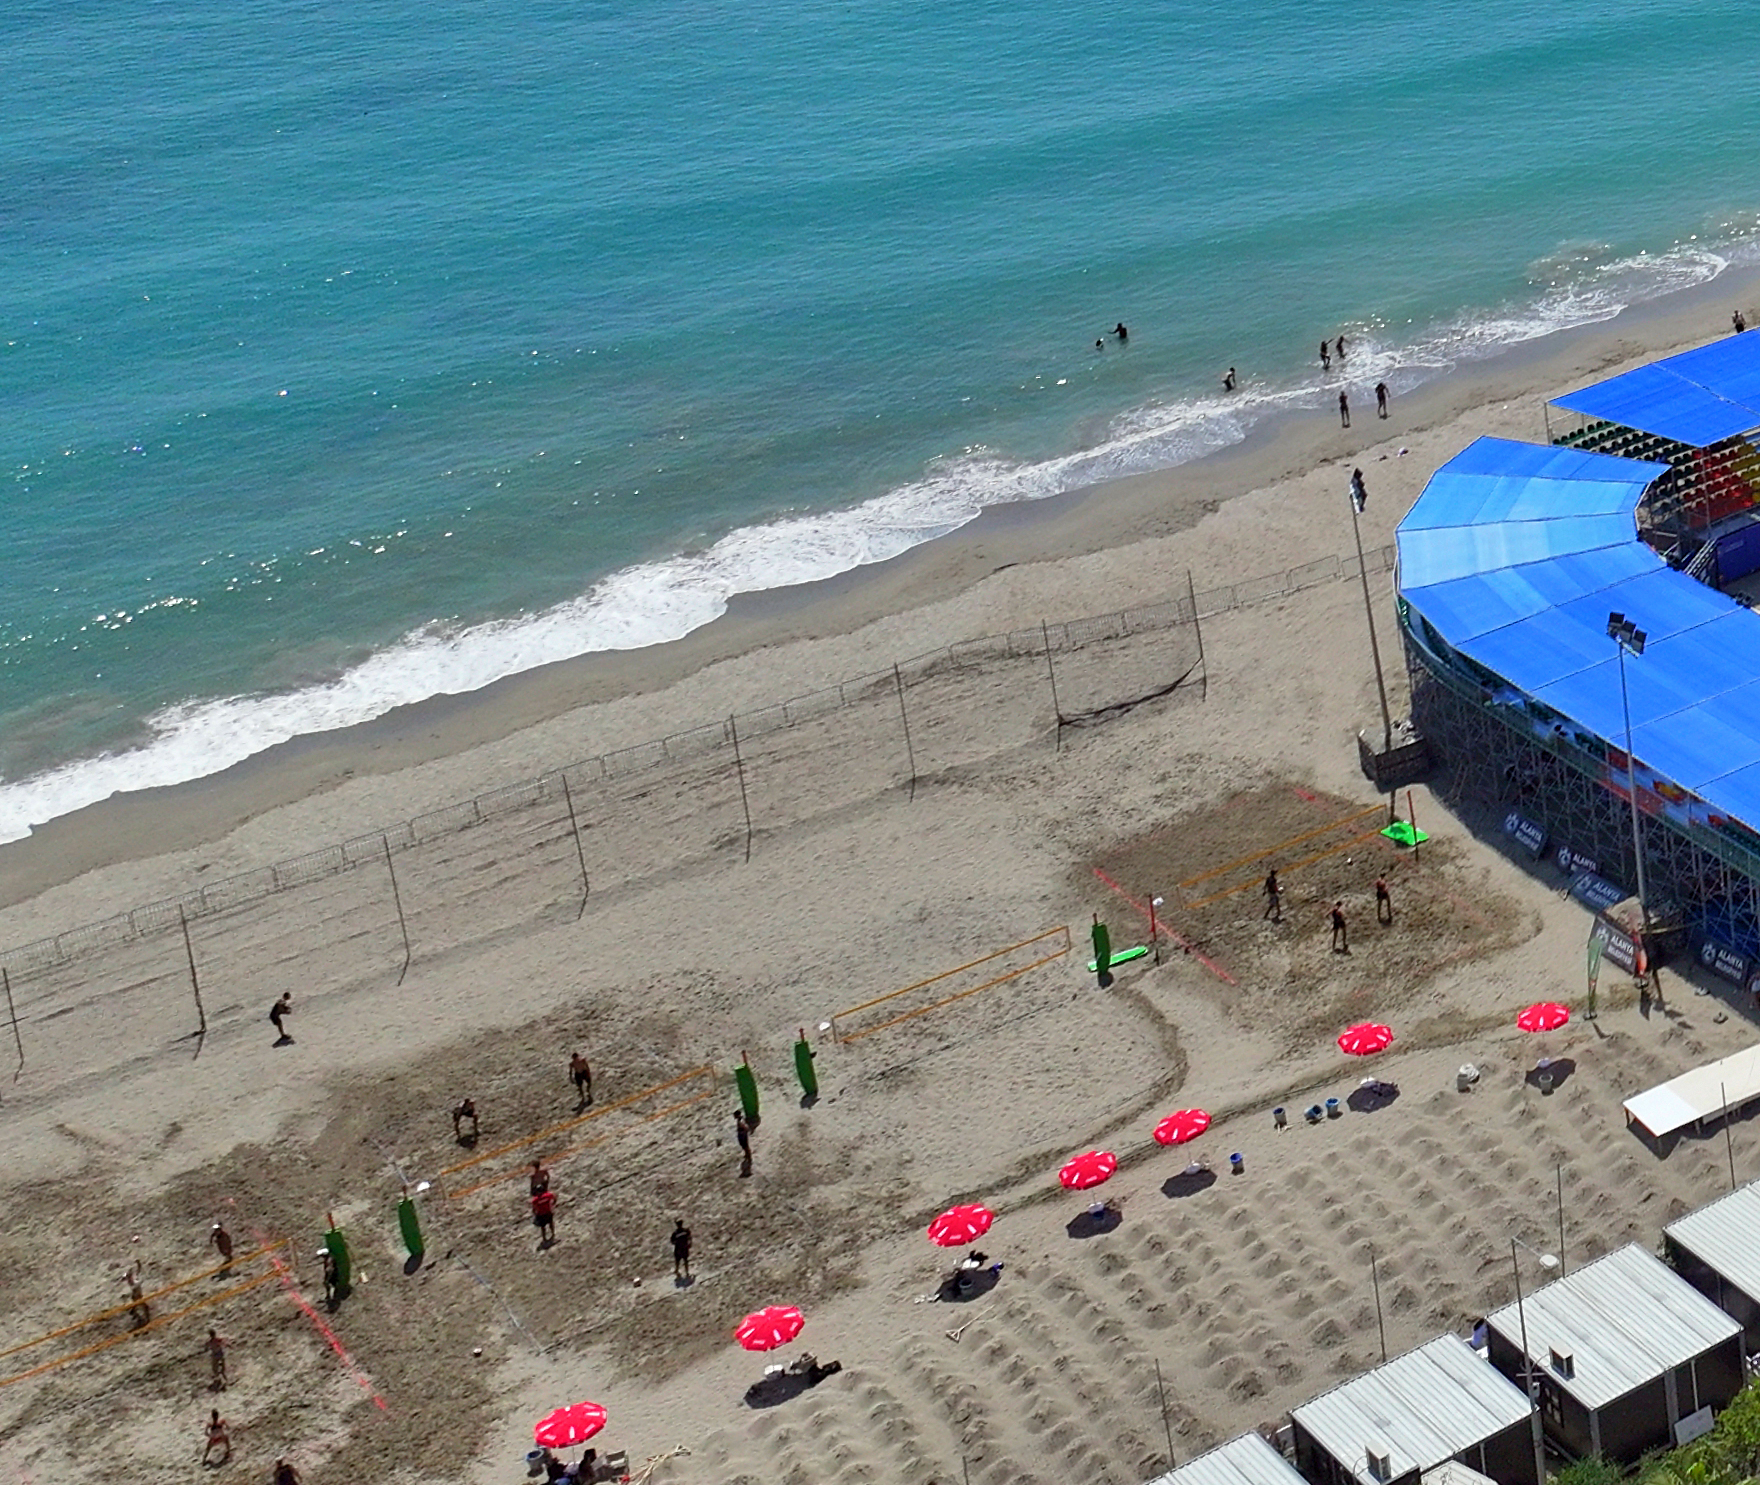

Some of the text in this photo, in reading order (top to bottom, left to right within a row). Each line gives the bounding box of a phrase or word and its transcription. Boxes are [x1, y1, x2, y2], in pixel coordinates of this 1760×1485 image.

[1592, 881, 1621, 902] ALANYA
[1610, 934, 1635, 957] ALANYA
[1717, 949, 1744, 970] ALANYA
